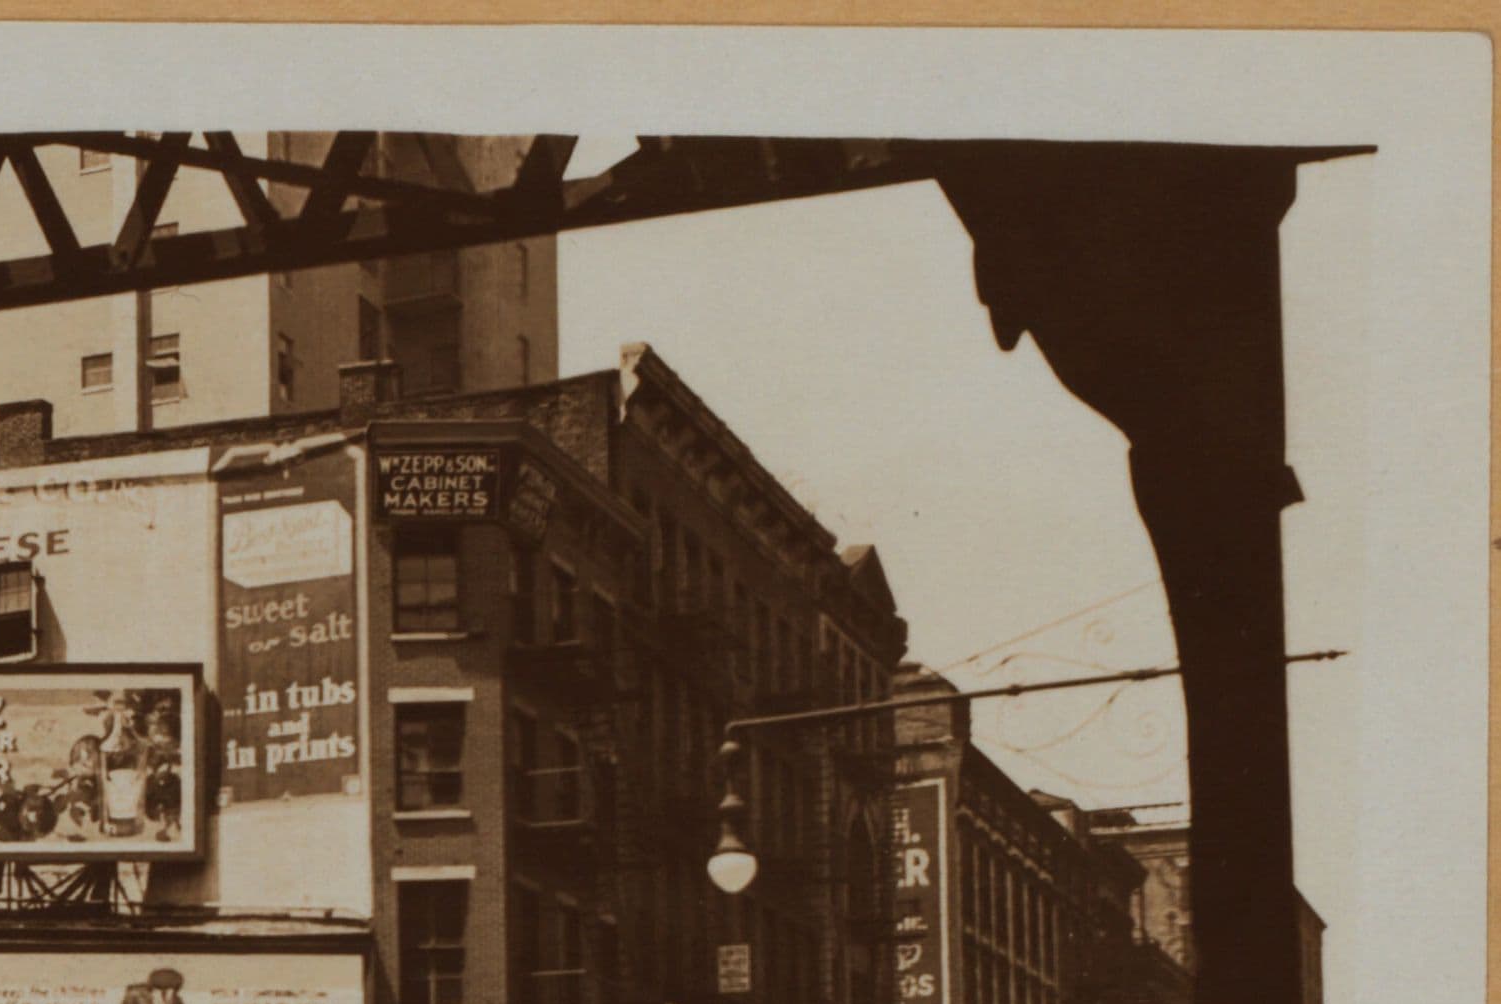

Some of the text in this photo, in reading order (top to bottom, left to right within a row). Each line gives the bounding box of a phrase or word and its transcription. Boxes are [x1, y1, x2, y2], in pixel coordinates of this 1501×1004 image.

[401, 455, 444, 474] ZEPP
[390, 475, 483, 491] CABINET
[384, 491, 489, 507] MAKERS
[225, 592, 310, 629] sweet
[249, 611, 353, 654] or salt
[286, 675, 357, 710] tubs
[267, 710, 310, 737] and
[226, 730, 357, 774] in prints
